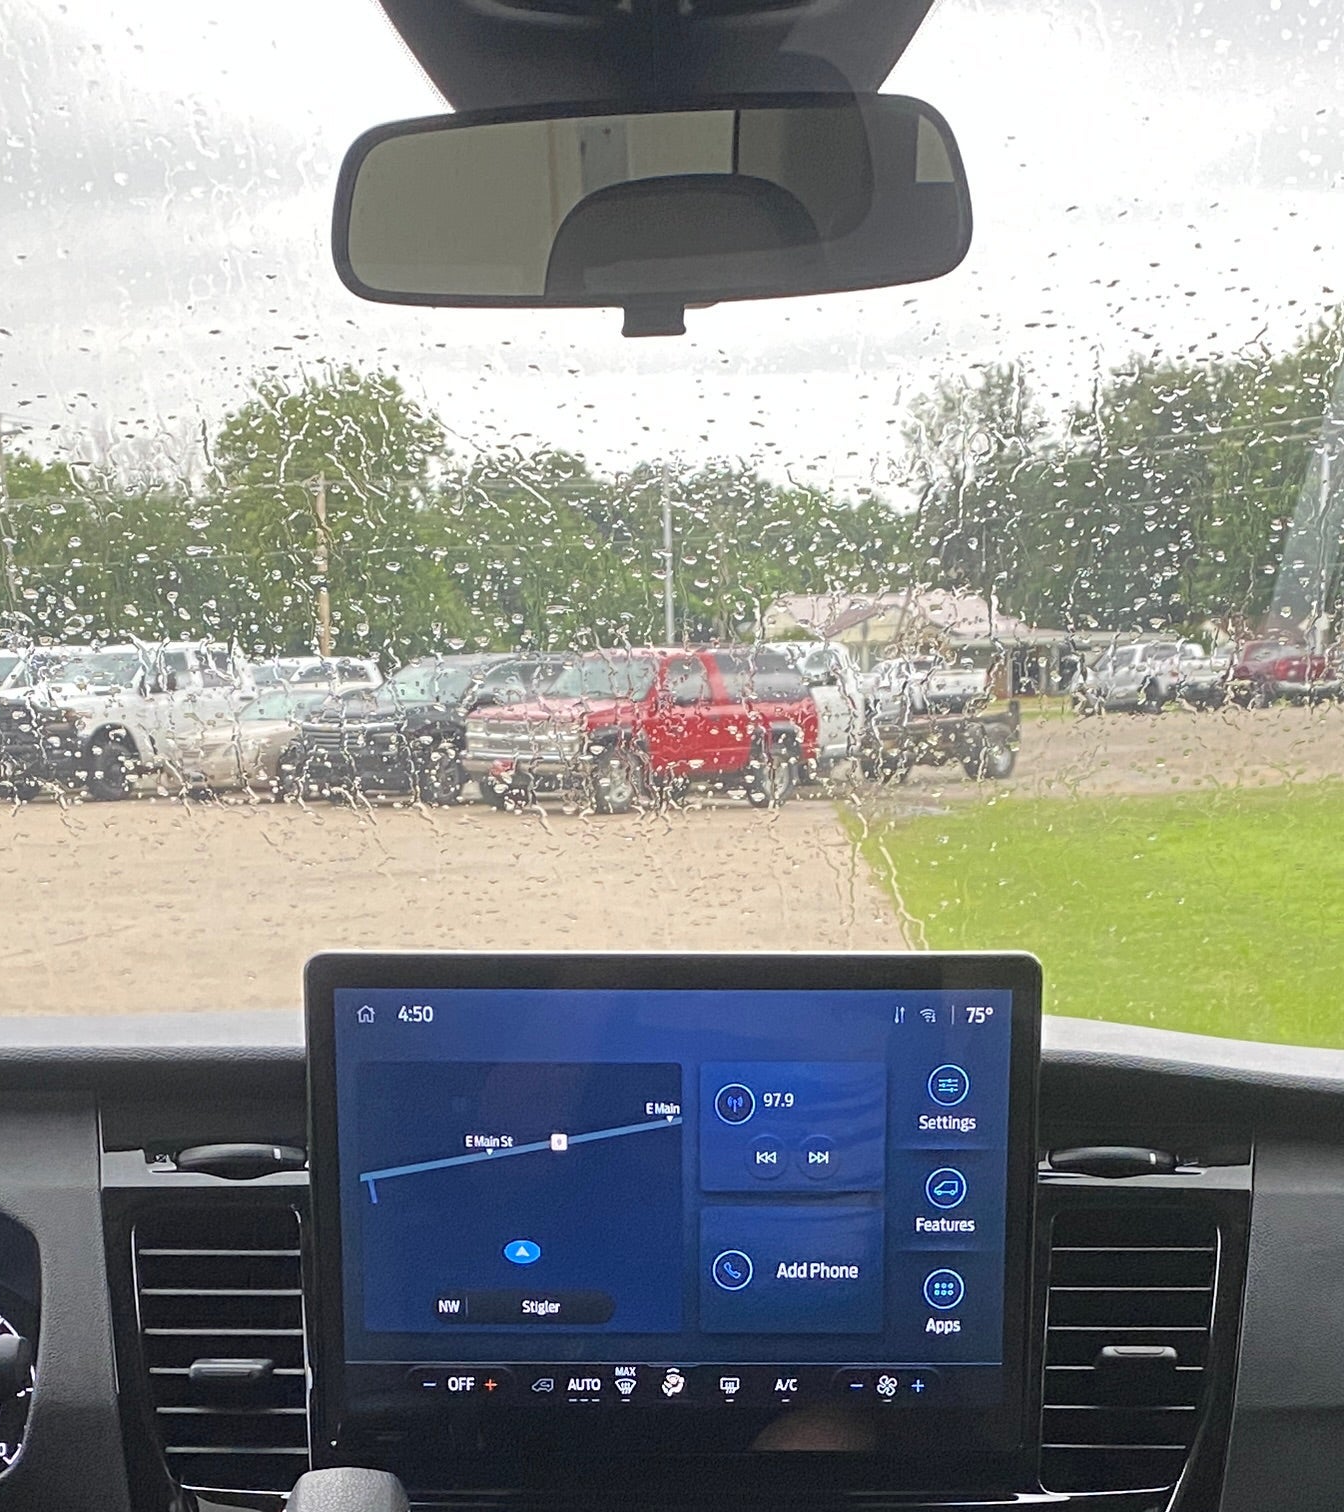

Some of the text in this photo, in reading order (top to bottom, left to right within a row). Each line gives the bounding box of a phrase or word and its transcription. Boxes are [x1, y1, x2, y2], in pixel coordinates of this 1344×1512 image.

[398, 1005, 434, 1023] 4:50
[966, 1006, 994, 1024] 75°
[763, 1092, 794, 1108] 97.9
[646, 1102, 680, 1115] E Main
[919, 1115, 976, 1132] Settings
[465, 1136, 514, 1148] E Main St
[916, 1217, 975, 1232] Features
[776, 1262, 859, 1279] Add Phone
[438, 1300, 460, 1313] NW
[522, 1300, 560, 1316] Stigler
[925, 1317, 961, 1335] Apps
[615, 1367, 636, 1376] MAX
[448, 1377, 475, 1391] OFF
[568, 1378, 601, 1391] AUTO
[774, 1378, 798, 1392] A/C
